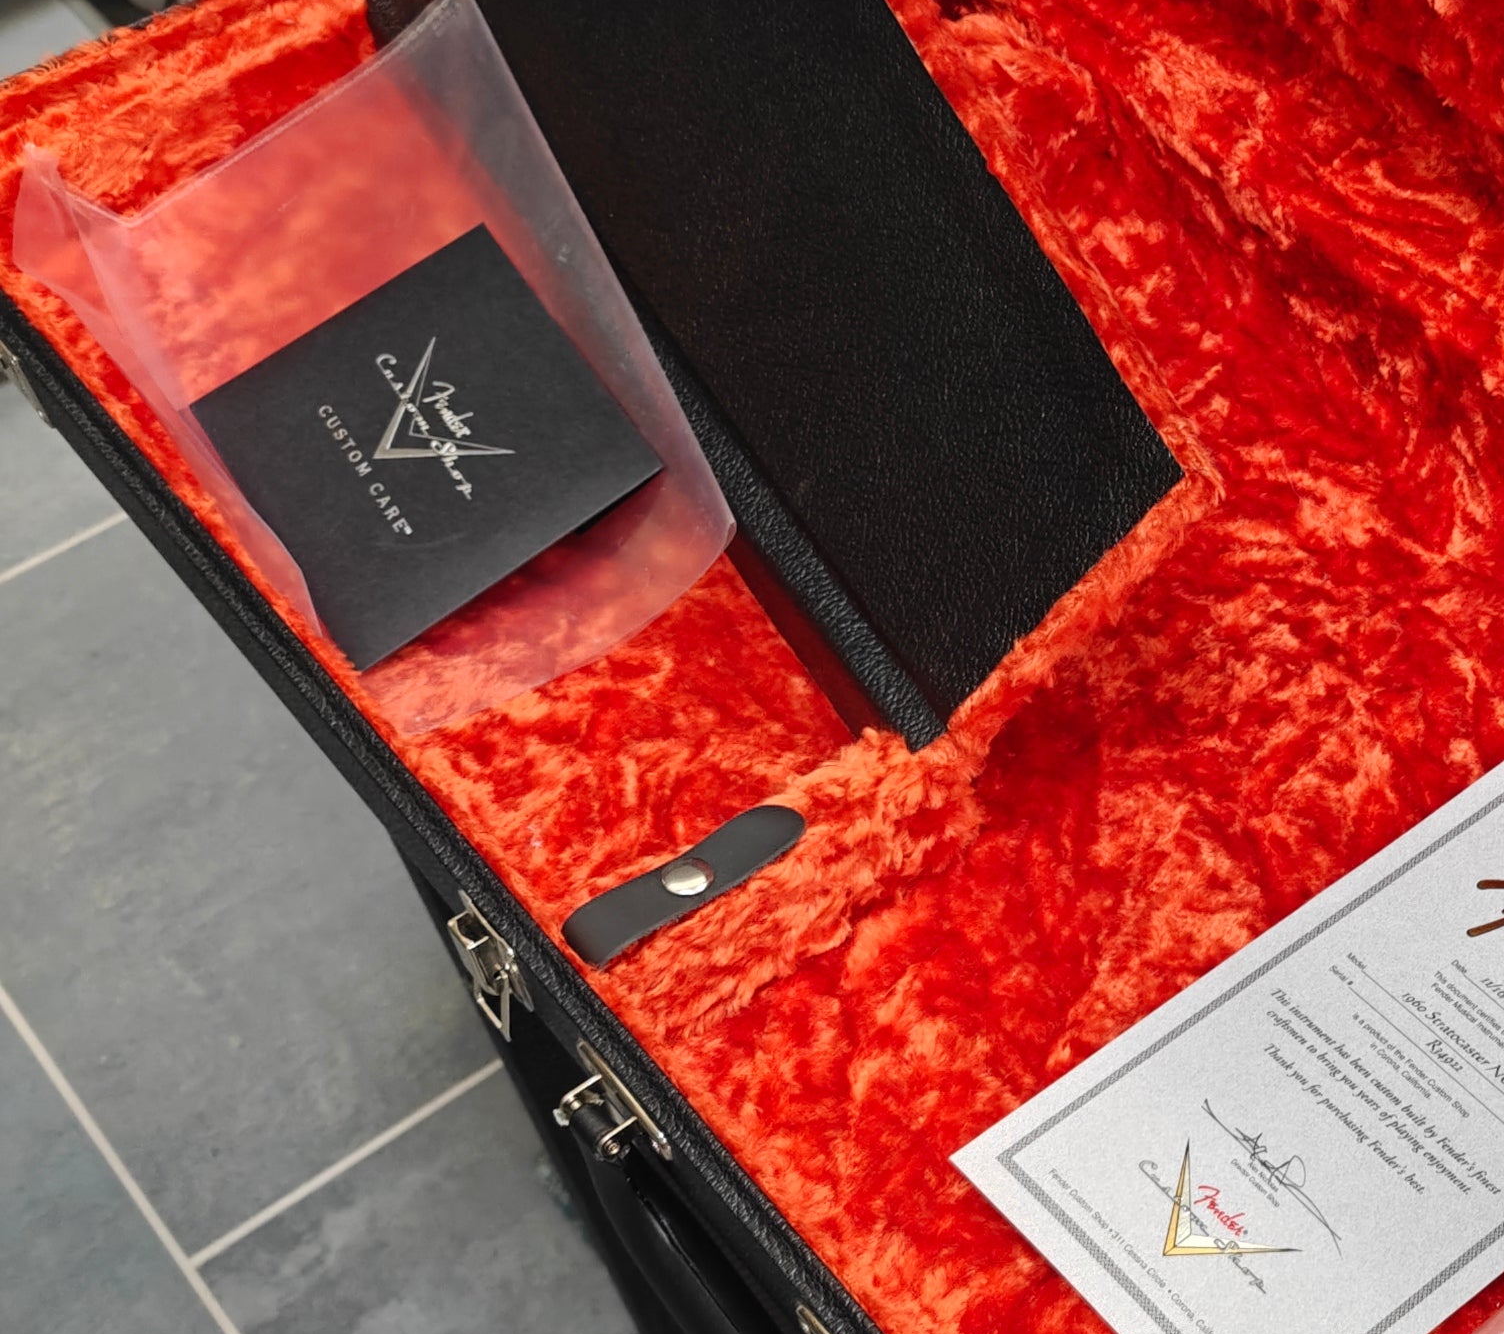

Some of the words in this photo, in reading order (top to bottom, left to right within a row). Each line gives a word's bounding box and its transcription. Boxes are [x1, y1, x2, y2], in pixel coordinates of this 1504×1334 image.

[318, 405, 372, 477] CUSTOM
[1264, 1043, 1296, 1071] Thank
[1286, 1070, 1309, 1086] you
[1302, 1084, 1323, 1097] for
[1316, 1098, 1370, 1144] purchasing
[1367, 1140, 1407, 1175] Fender's
[1404, 1173, 1425, 1195] best.
[1266, 1010, 1308, 1045] craftsmen
[1316, 1052, 1342, 1078] bring
[1335, 1074, 1358, 1090] you
[1352, 1090, 1381, 1111] years
[1385, 1121, 1425, 1154] playing
[1423, 1152, 1471, 1195] enjoyment.
[1270, 988, 1291, 1007] This
[1288, 1005, 1337, 1046] instrument
[1333, 1043, 1351, 1060] has
[1349, 1057, 1372, 1079] been
[1370, 1078, 1402, 1106] custom
[1401, 1104, 1427, 1127] built
[1423, 1125, 1438, 1138] by
[1436, 1137, 1476, 1172] Fender's
[1468, 1170, 1501, 1195] finest
